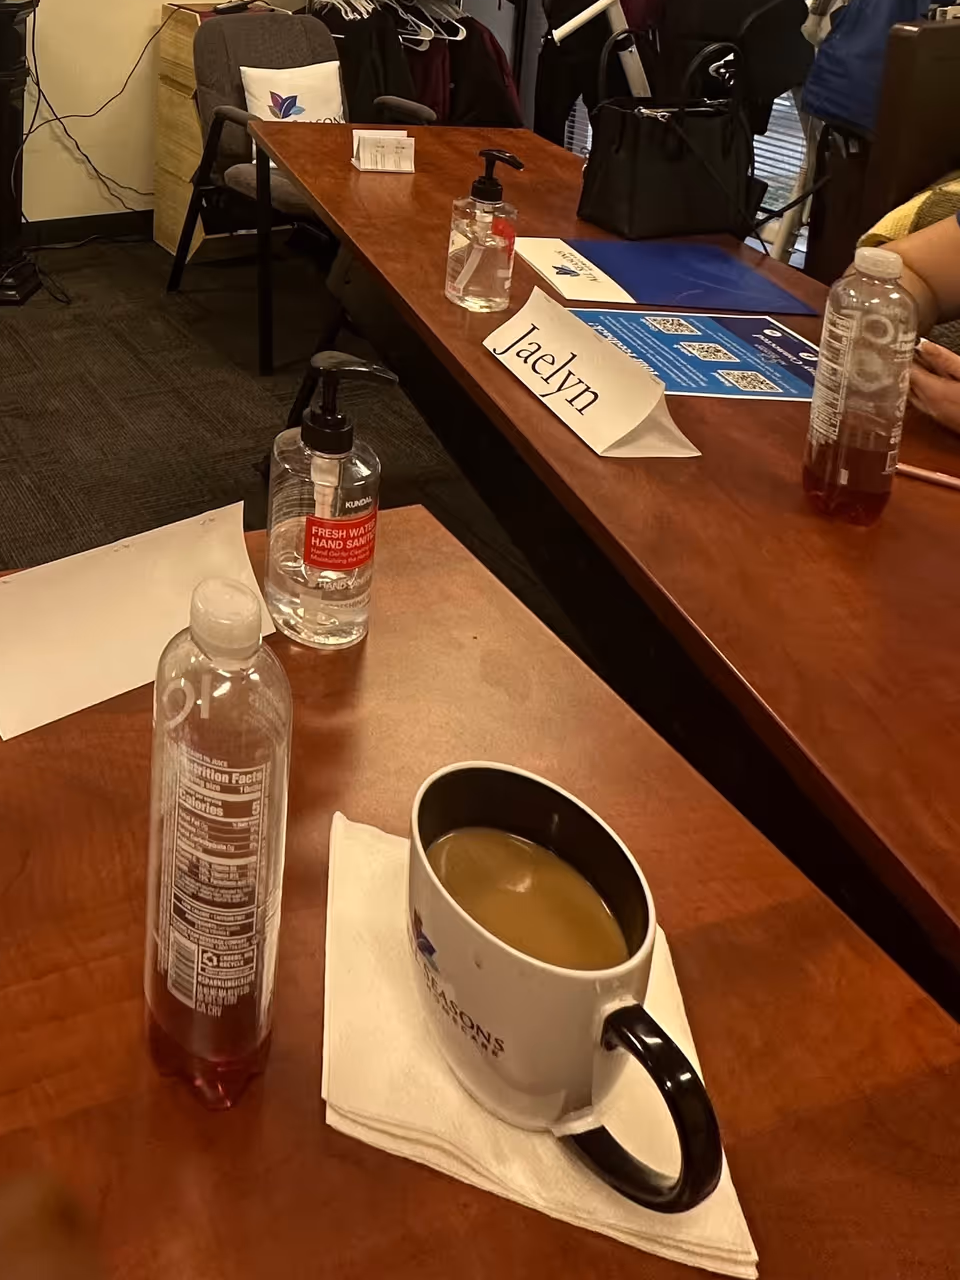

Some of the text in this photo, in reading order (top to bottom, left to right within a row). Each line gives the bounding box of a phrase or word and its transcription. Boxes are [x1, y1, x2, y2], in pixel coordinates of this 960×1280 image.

[492, 323, 599, 416] Jaelyn
[345, 496, 373, 509] KUNDAL
[312, 526, 347, 540] FRESH
[311, 536, 344, 550] HAND
[232, 771, 263, 784] Facts
[180, 790, 261, 817] Calories 5
